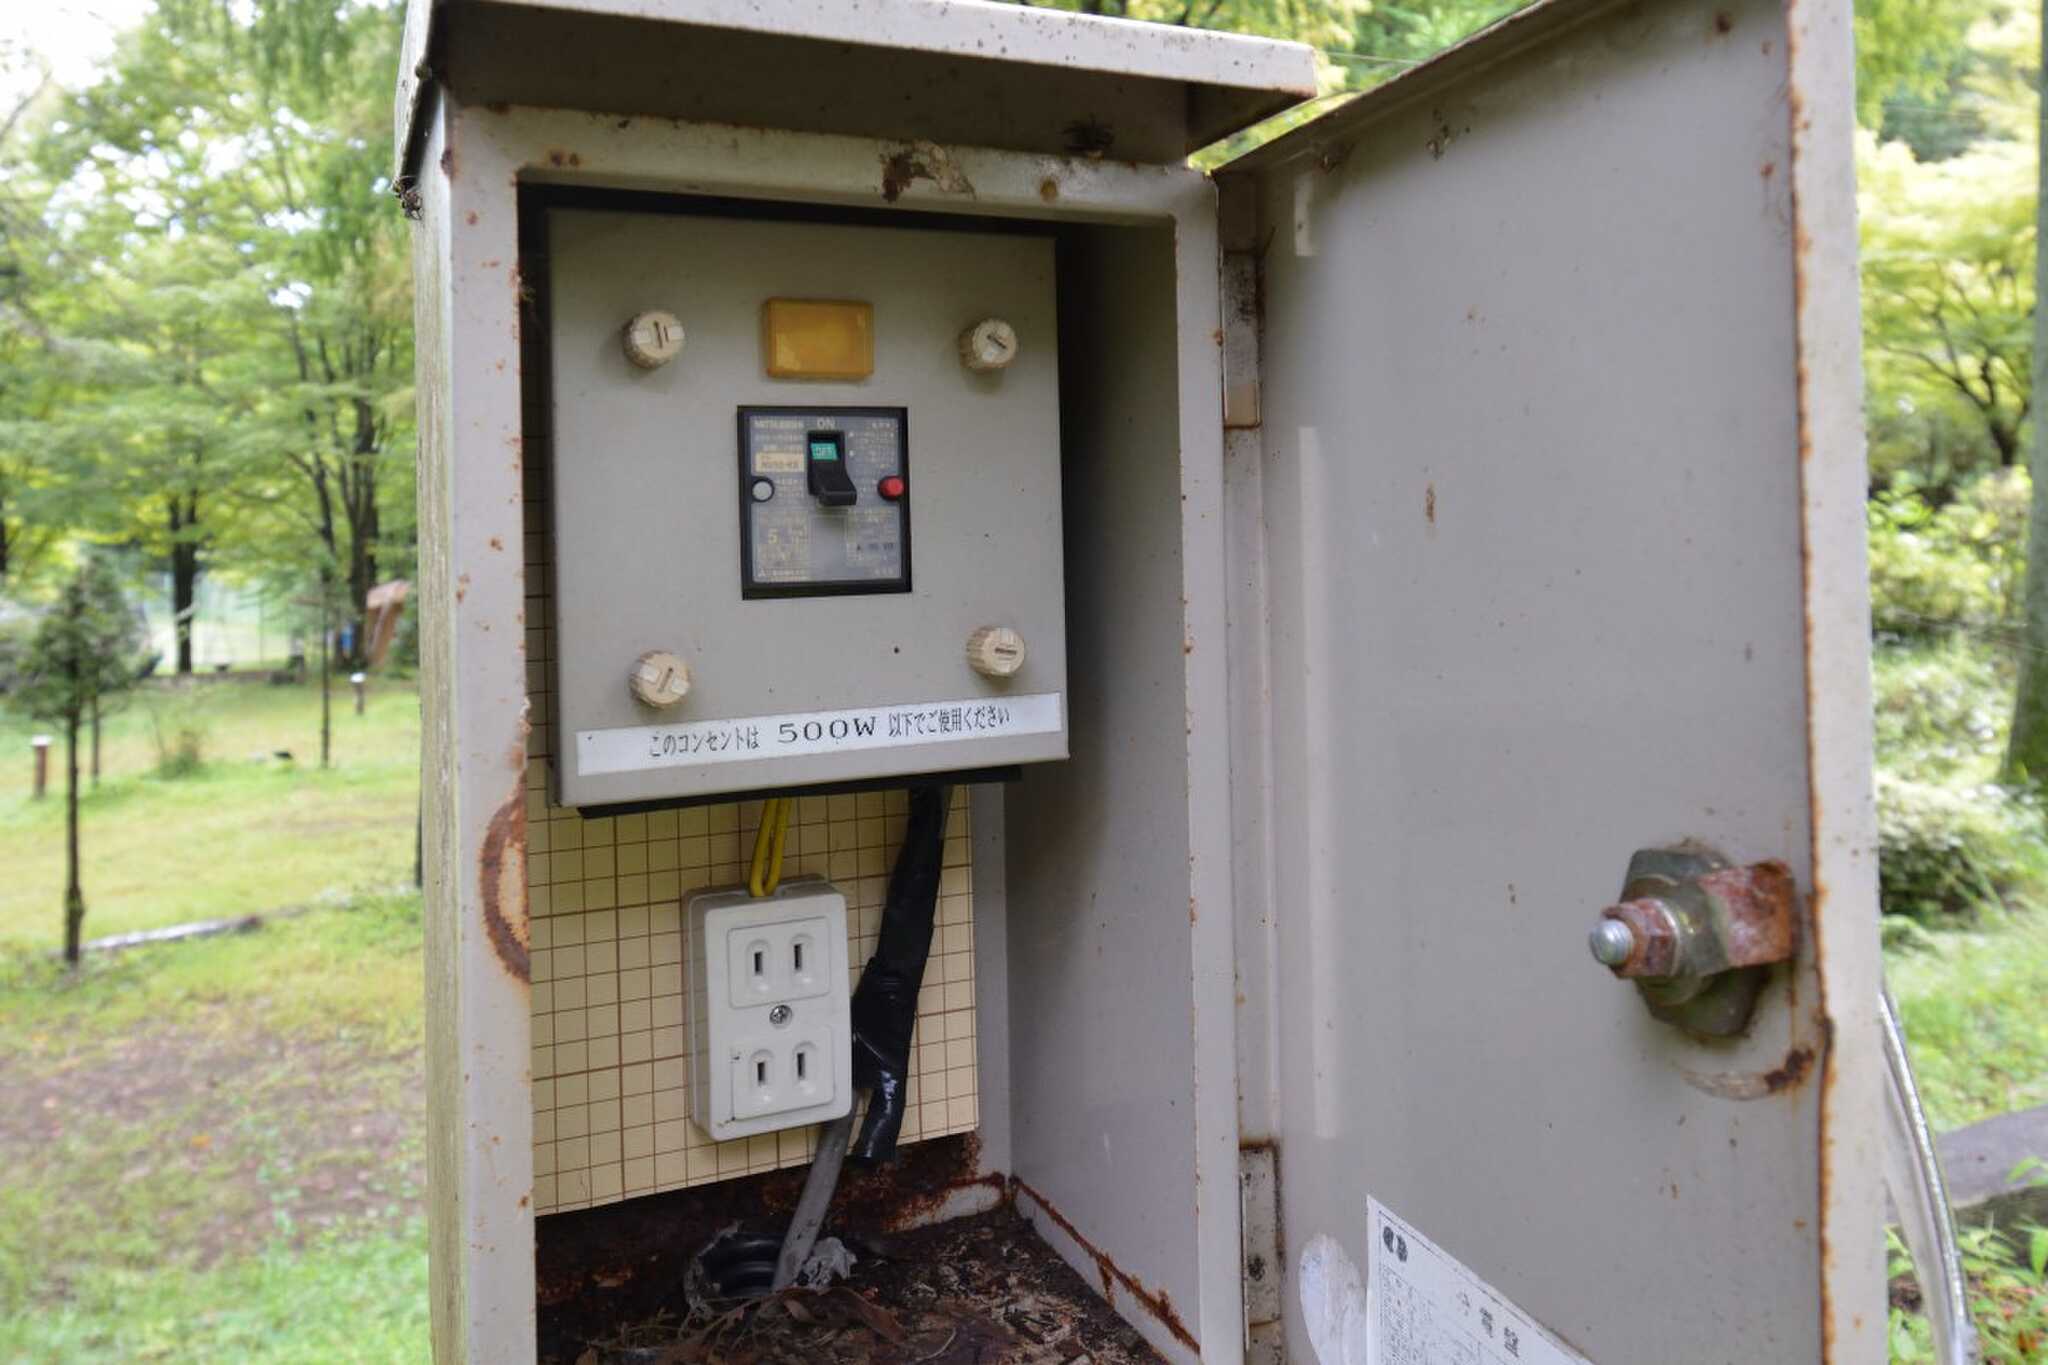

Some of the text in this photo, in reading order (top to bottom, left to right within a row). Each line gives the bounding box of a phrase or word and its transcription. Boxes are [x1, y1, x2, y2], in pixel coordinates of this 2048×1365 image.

[817, 418, 836, 429] ON
[650, 704, 1010, 757] このコンセントは 500W 以下でご使用ください
